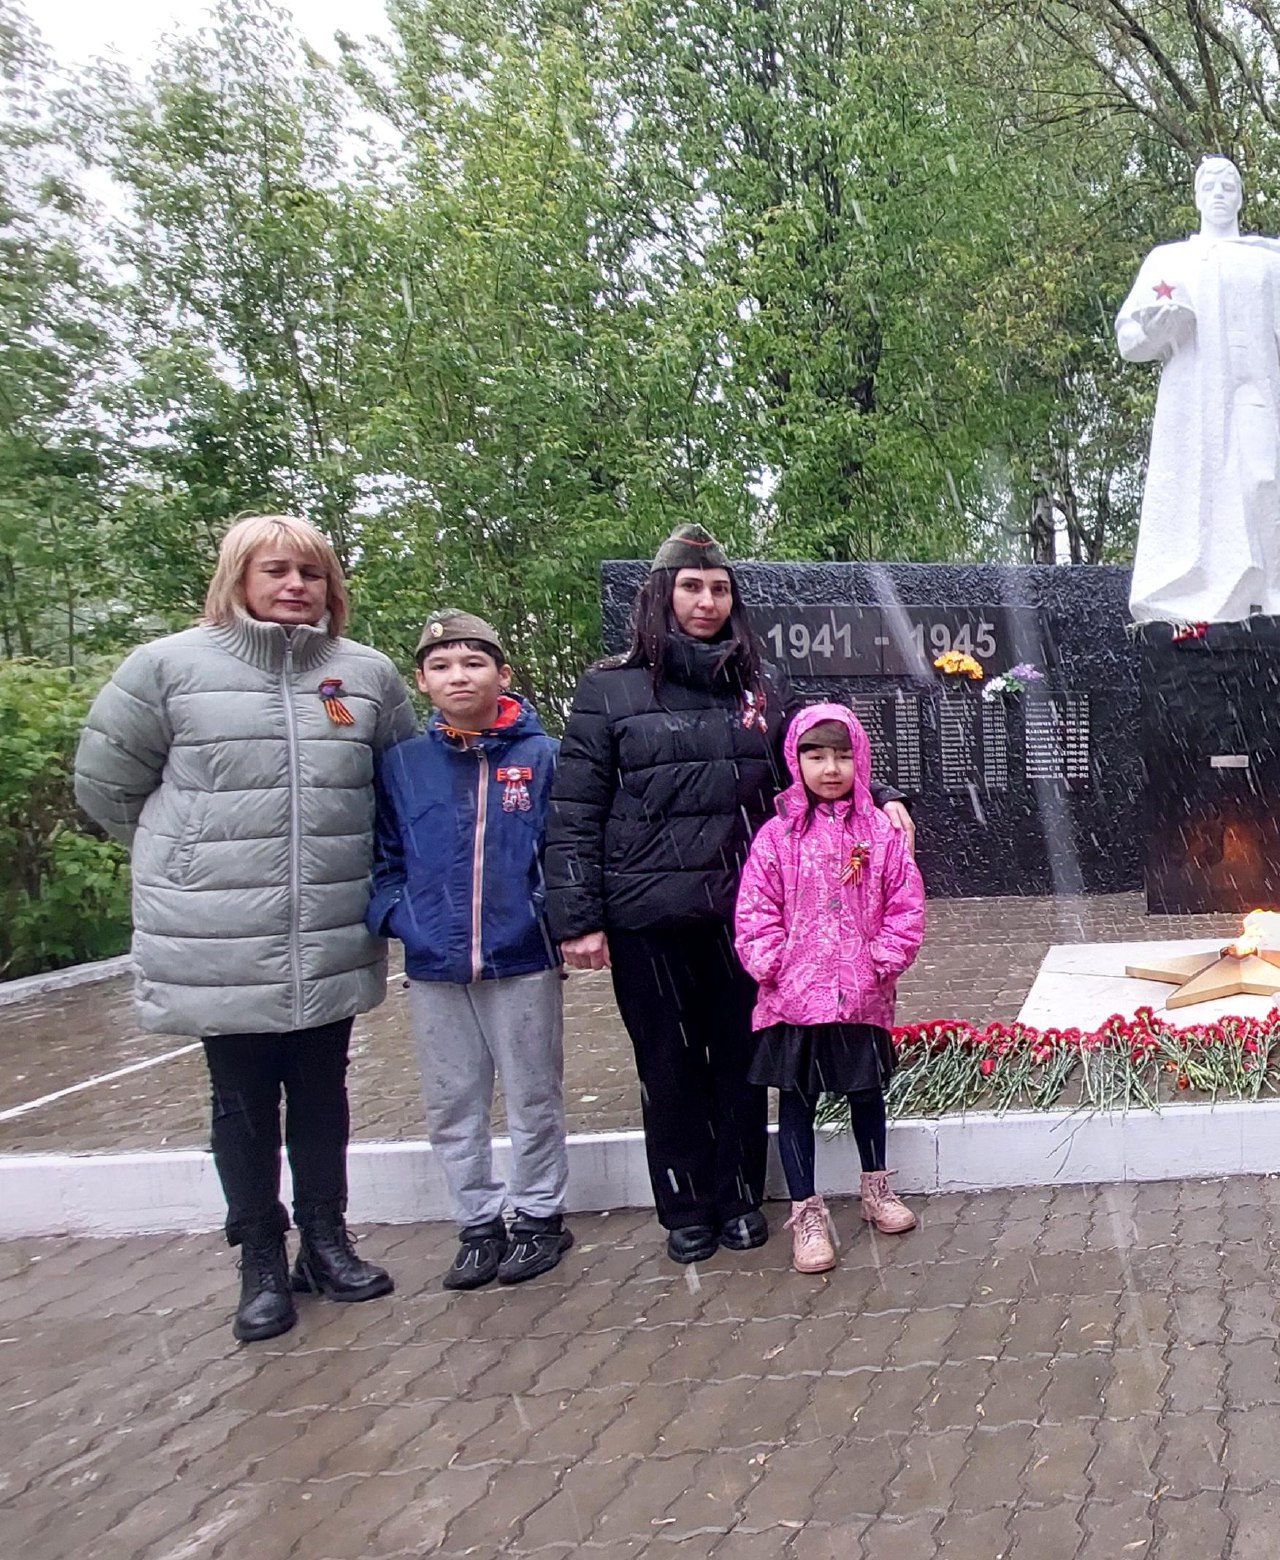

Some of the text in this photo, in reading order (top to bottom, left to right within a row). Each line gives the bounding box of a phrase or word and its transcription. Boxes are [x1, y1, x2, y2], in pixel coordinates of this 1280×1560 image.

[767, 623, 997, 658] 1941 - 1945
